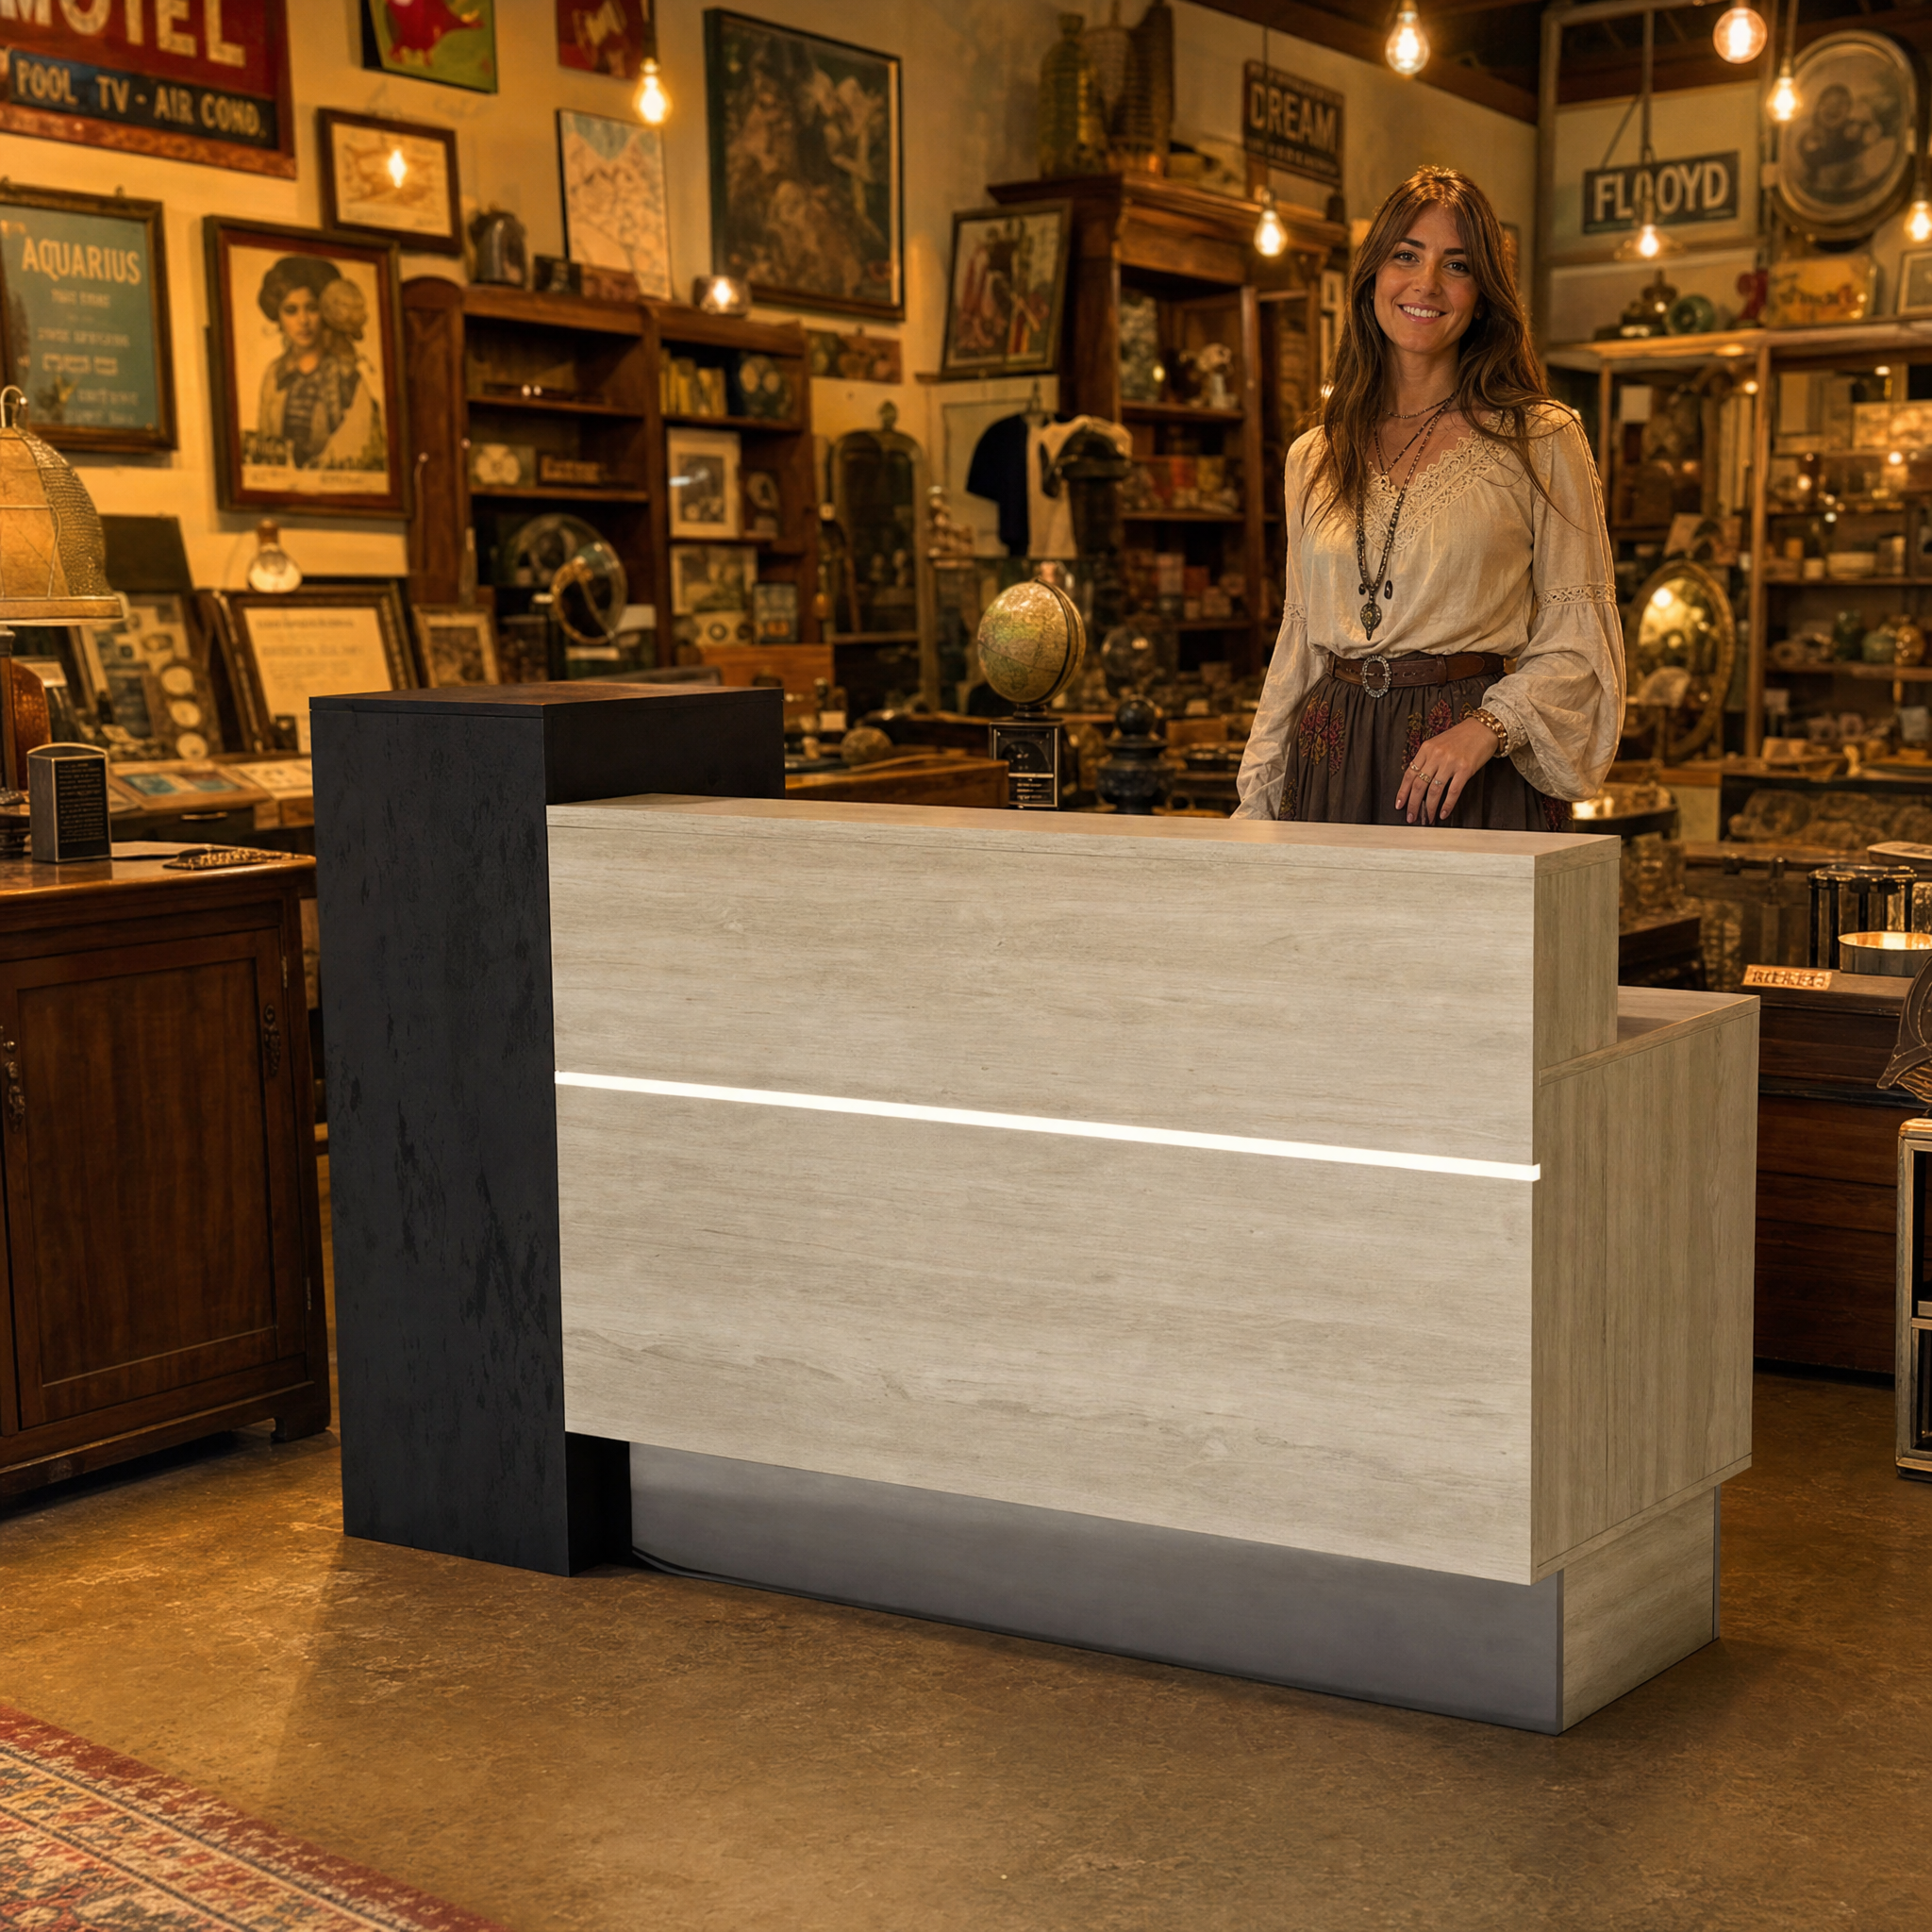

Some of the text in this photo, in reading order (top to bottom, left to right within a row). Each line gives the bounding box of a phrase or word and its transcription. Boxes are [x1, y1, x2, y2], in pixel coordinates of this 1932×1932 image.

[0, 0, 246, 68] TEL
[15, 58, 79, 107] POOL
[96, 75, 130, 114] TV
[154, 85, 194, 125] AIR
[1249, 80, 1337, 156] DREAM
[21, 236, 142, 286] AQUARIUS
